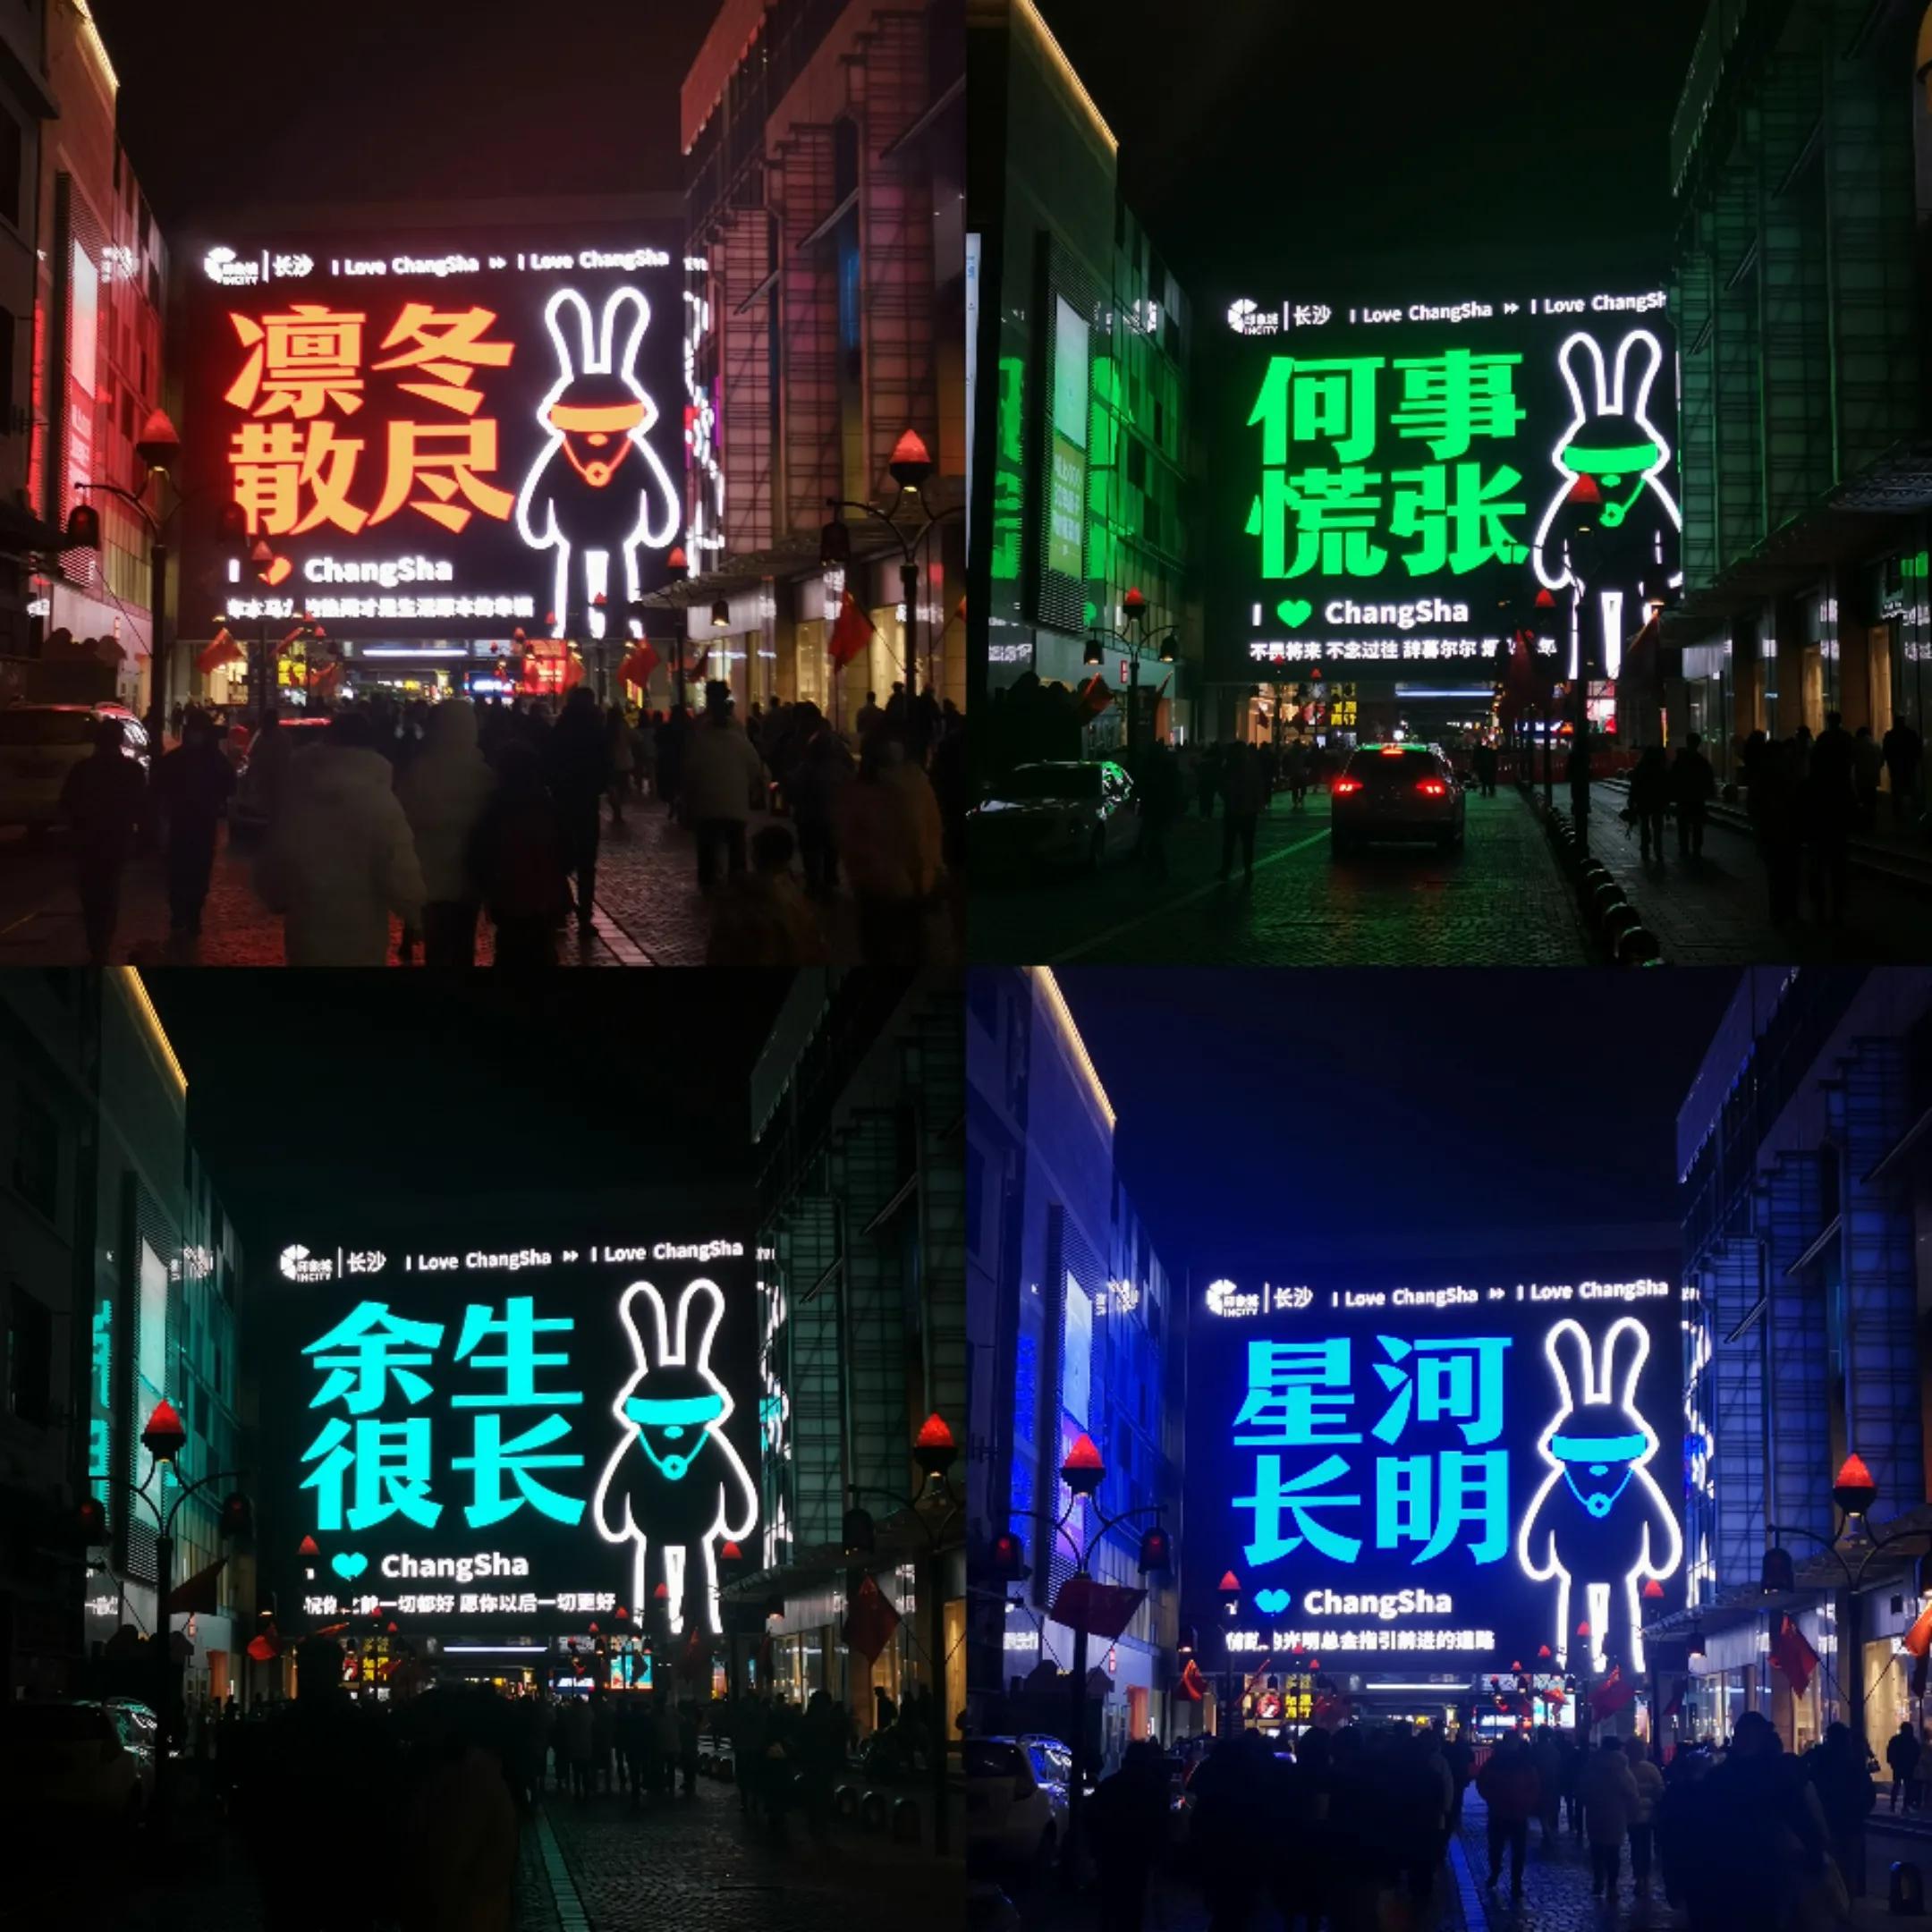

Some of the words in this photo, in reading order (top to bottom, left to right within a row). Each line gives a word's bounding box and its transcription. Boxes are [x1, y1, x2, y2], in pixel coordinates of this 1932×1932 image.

[332, 259, 340, 275] I
[344, 258, 387, 275] Love
[391, 254, 480, 277] ChangSha
[517, 253, 525, 271] I
[530, 253, 576, 270] Love
[579, 248, 670, 271] ChangSha
[1293, 304, 1332, 326] 长沙
[1350, 309, 1356, 324] I
[1363, 309, 1402, 323] Love
[1409, 301, 1493, 323] ChangSha
[1530, 299, 1537, 315] I
[1545, 299, 1586, 314] Love
[225, 303, 516, 418] 凛冬
[1246, 349, 1527, 464] 何事
[227, 419, 516, 535] 散尽
[1244, 462, 1530, 579] 慌张
[228, 558, 241, 583] I
[303, 555, 453, 589] ChangSha
[1252, 603, 1262, 626] I
[1325, 597, 1469, 630] ChangSha
[1250, 640, 1322, 661] 不畏将来
[1326, 640, 1399, 660] 不念过往
[346, 1250, 386, 1273] 长沙
[406, 1255, 411, 1271] I
[419, 1255, 459, 1271] Love
[465, 1249, 552, 1270] ChangSha
[590, 1246, 597, 1263] I
[604, 1246, 647, 1262] Love
[653, 1240, 743, 1262] ChangSha
[1273, 1286, 1314, 1309] 长沙
[1332, 1291, 1338, 1308] I
[1345, 1291, 1385, 1307] Love
[1392, 1285, 1479, 1308] ChangSha
[1516, 1284, 1524, 1301] I
[1530, 1284, 1573, 1301] Love
[1579, 1279, 1669, 1301] ChangSha
[301, 1296, 584, 1415] 余生
[1233, 1335, 1513, 1446] 星河
[299, 1413, 587, 1531] 很长
[1232, 1450, 1510, 1567] 长明
[381, 1552, 530, 1583] ChangSha
[460, 1592, 616, 1613] 愿你以后一切更好
[1303, 1589, 1452, 1621] ChangSha
